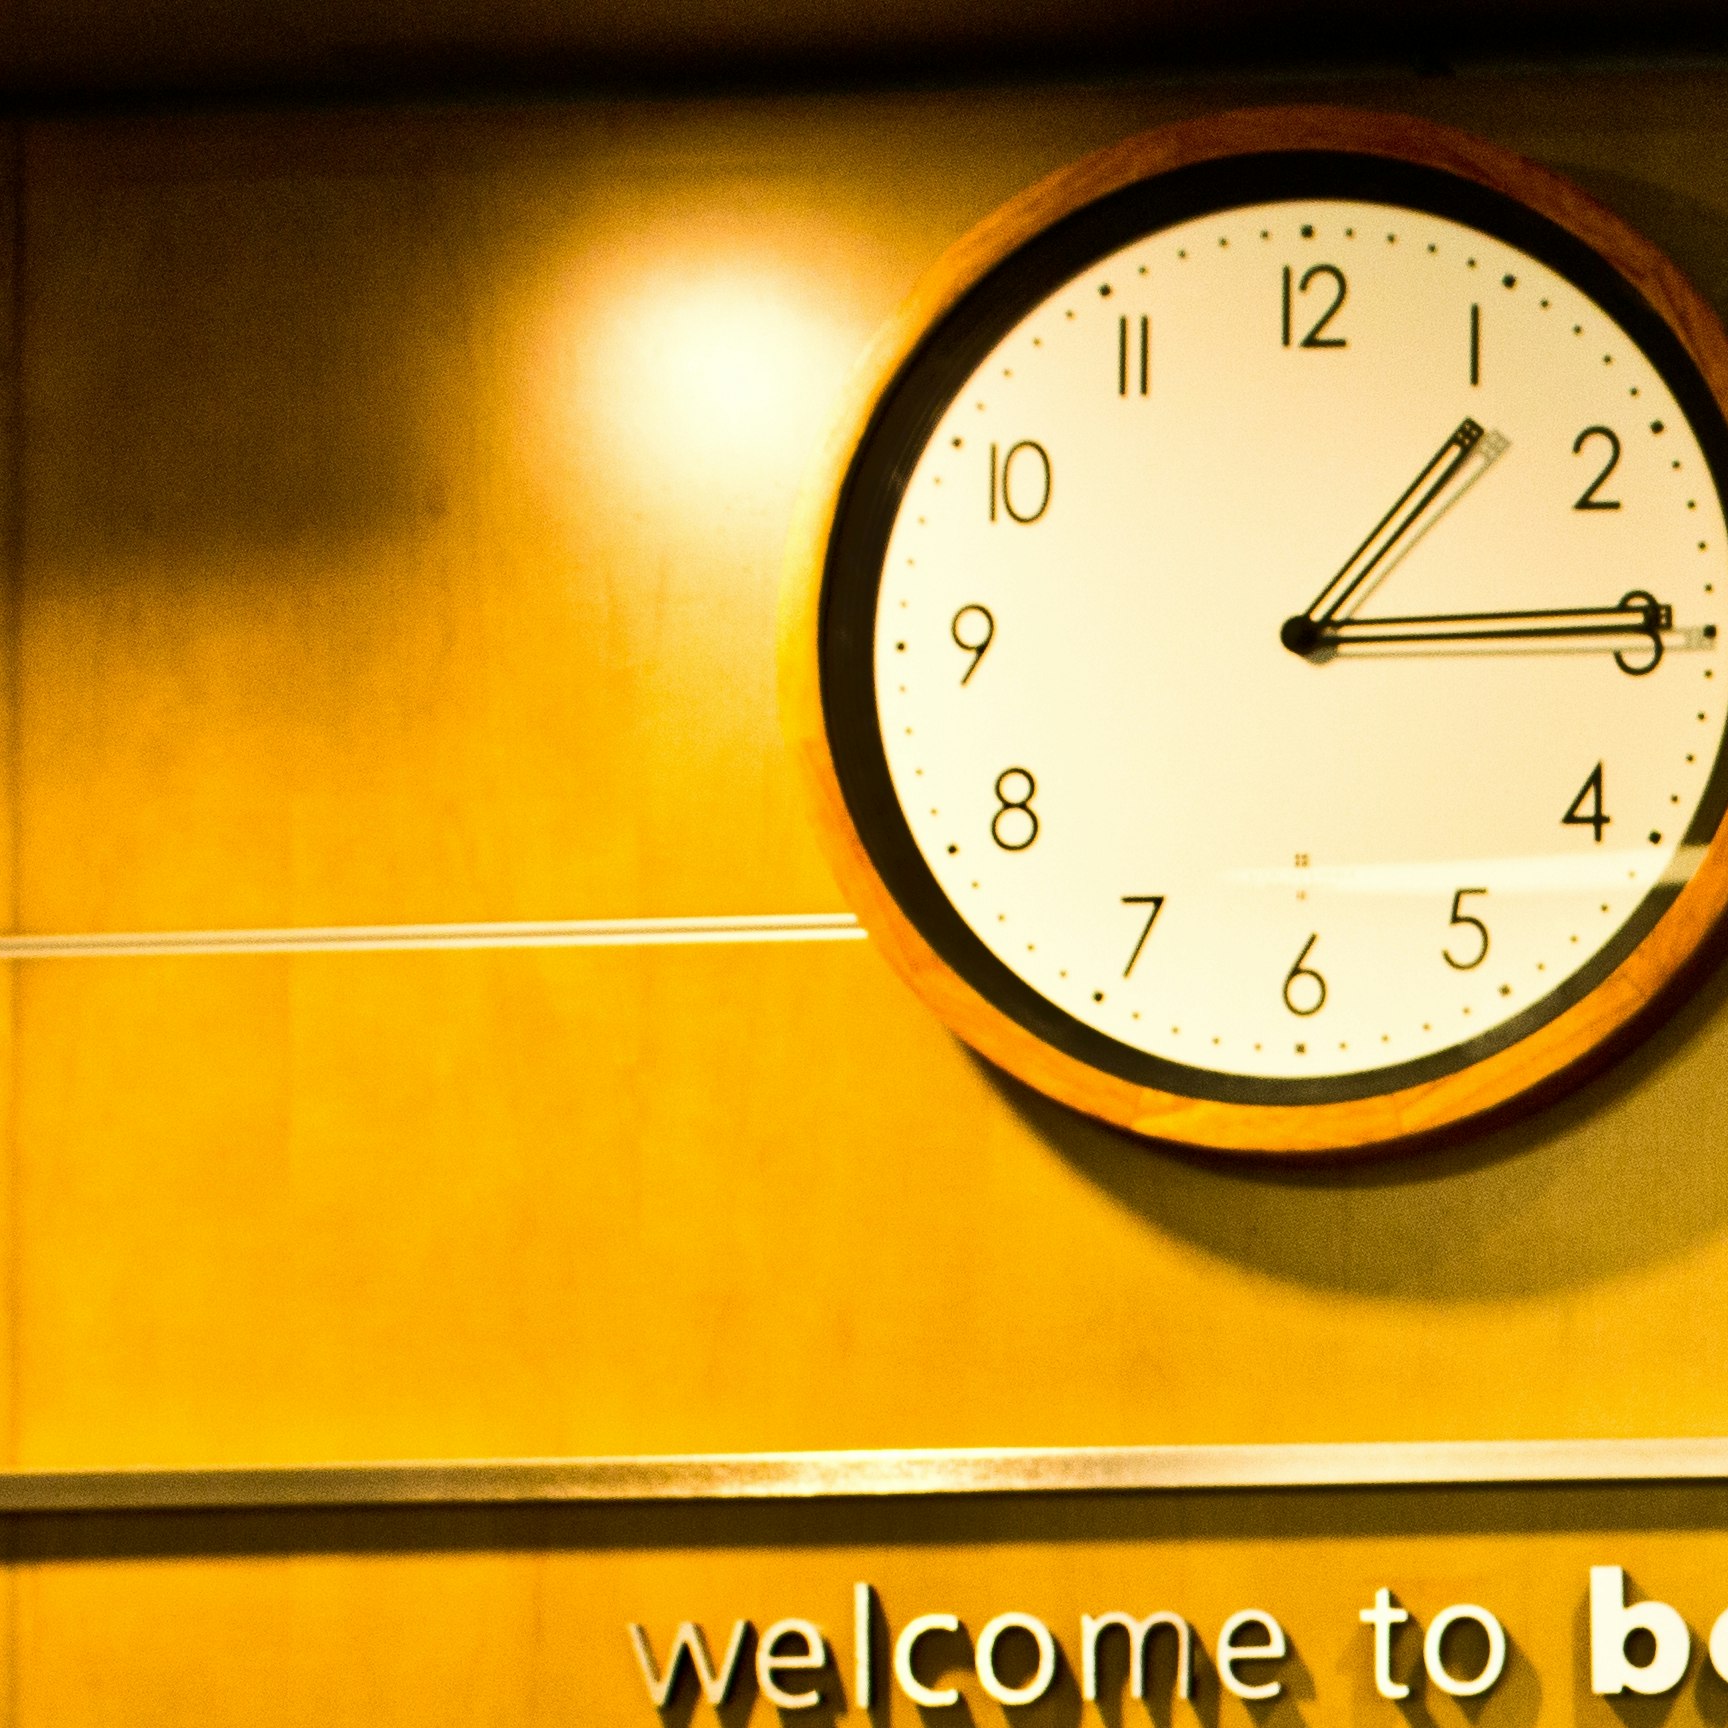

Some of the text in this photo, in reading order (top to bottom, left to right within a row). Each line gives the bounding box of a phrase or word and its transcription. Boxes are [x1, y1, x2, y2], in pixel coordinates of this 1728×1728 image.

[1281, 263, 1348, 350] 12
[1469, 303, 1481, 387] 1
[1118, 315, 1150, 397] 11
[989, 440, 1052, 524] 10
[1572, 425, 1622, 512] 2
[950, 603, 995, 685] 9
[1612, 589, 1664, 676] 3
[990, 767, 1039, 852] 8
[1561, 761, 1611, 843] 4
[1121, 895, 1165, 977] 7
[1442, 888, 1489, 971] 5
[1282, 933, 1327, 1017] 6
[629, 1582, 1287, 1709] welcome
[1359, 1587, 1506, 1699] to
